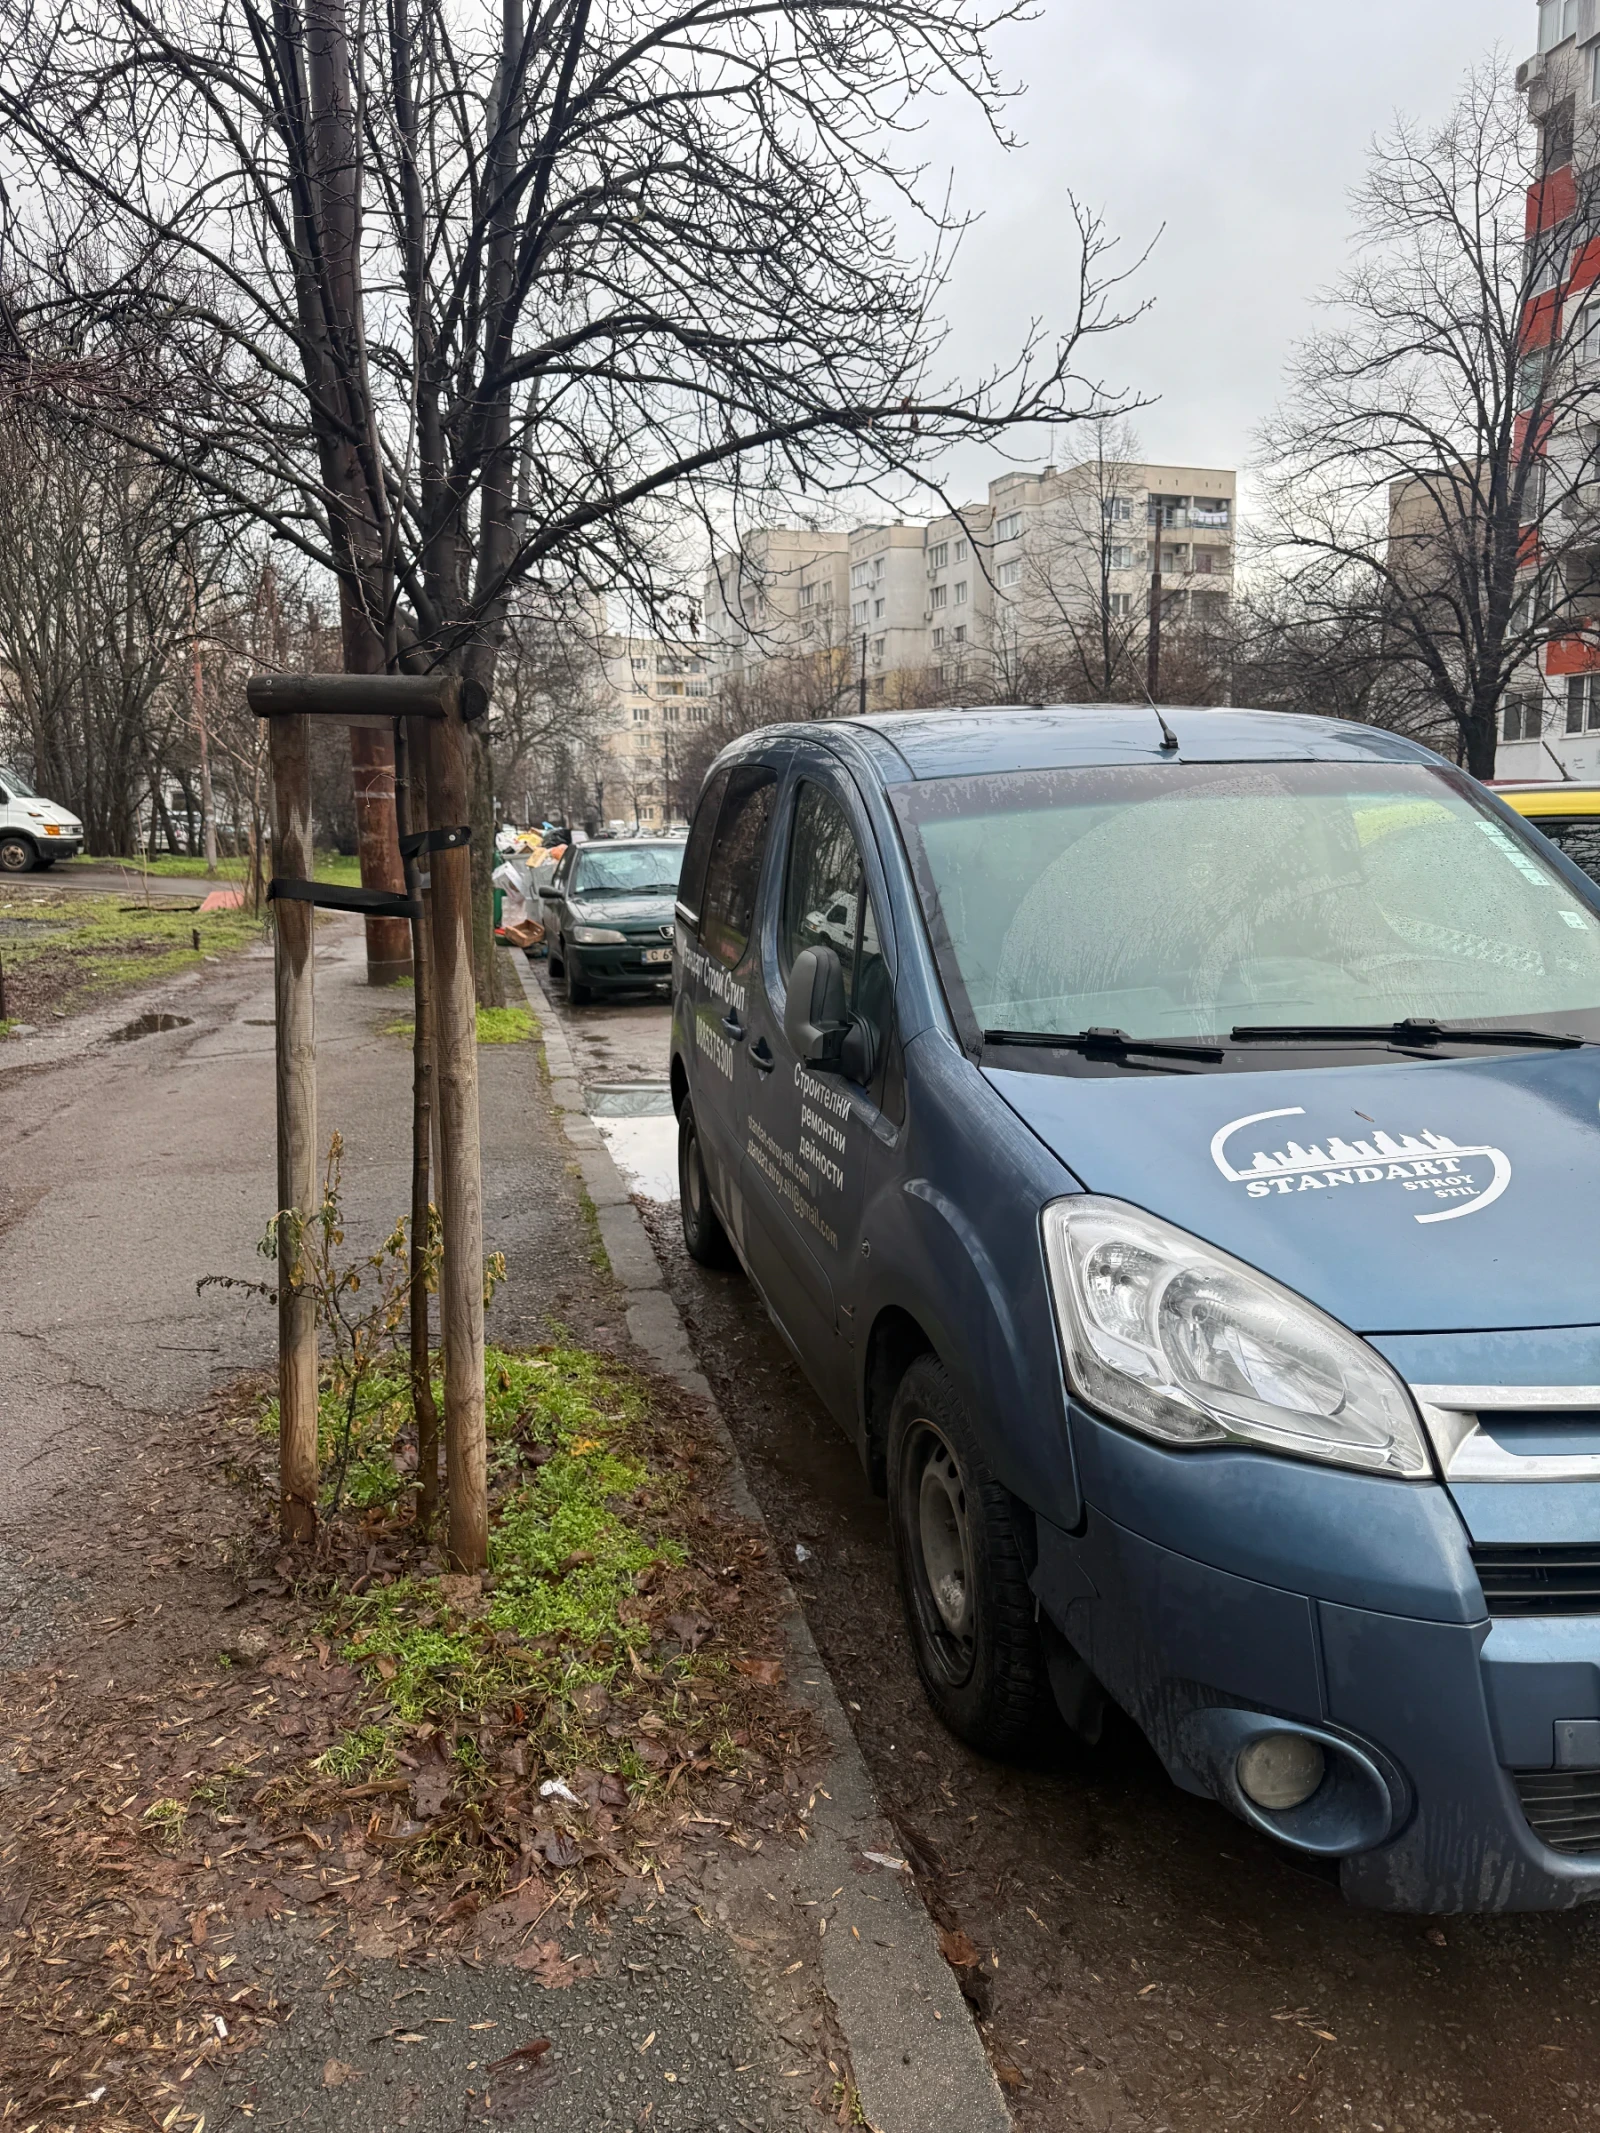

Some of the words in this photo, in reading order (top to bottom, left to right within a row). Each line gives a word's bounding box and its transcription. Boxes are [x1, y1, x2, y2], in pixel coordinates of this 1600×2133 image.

[704, 957, 726, 998] Строй
[725, 971, 745, 1012] Стил
[794, 1062, 852, 1121] Строителни
[801, 1104, 846, 1154] ремонтни
[799, 1135, 844, 1191] дейности
[1246, 1157, 1461, 1198] STANDART
[1402, 1174, 1475, 1191] STROY
[1434, 1186, 1480, 1199] STIL
